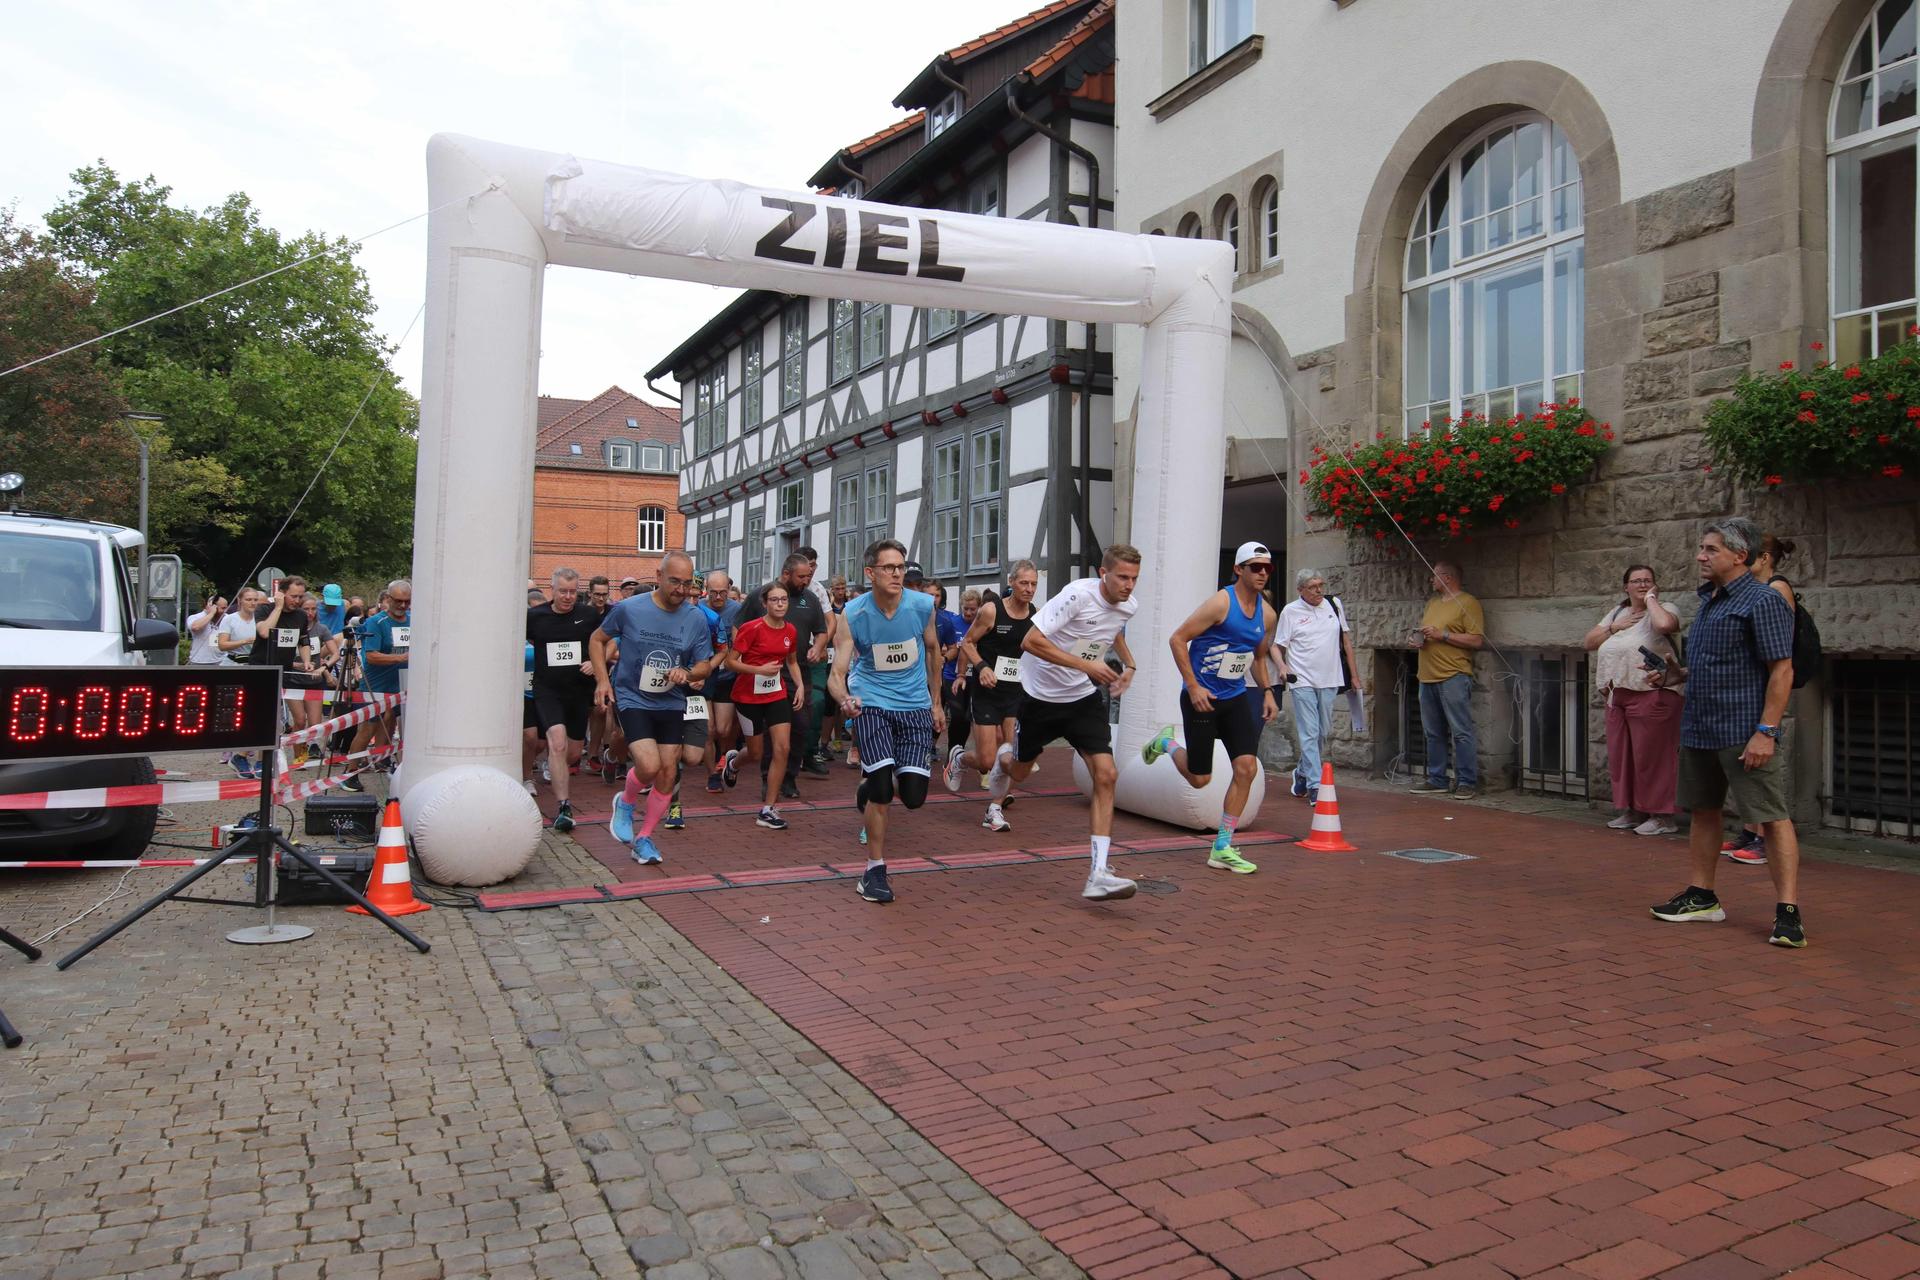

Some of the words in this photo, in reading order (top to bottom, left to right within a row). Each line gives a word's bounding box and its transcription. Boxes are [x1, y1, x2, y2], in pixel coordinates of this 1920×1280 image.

[755, 196, 965, 282] ZIEL
[640, 630, 682, 642] SportSch
[556, 651, 573, 660] 329
[886, 653, 908, 664] 400
[648, 661, 669, 670] RUN
[1229, 664, 1246, 673] 302
[1003, 667, 1017, 676] 356
[762, 679, 776, 688] 450
[11, 686, 244, 741] 0:00:01
[688, 705, 704, 713] 384
